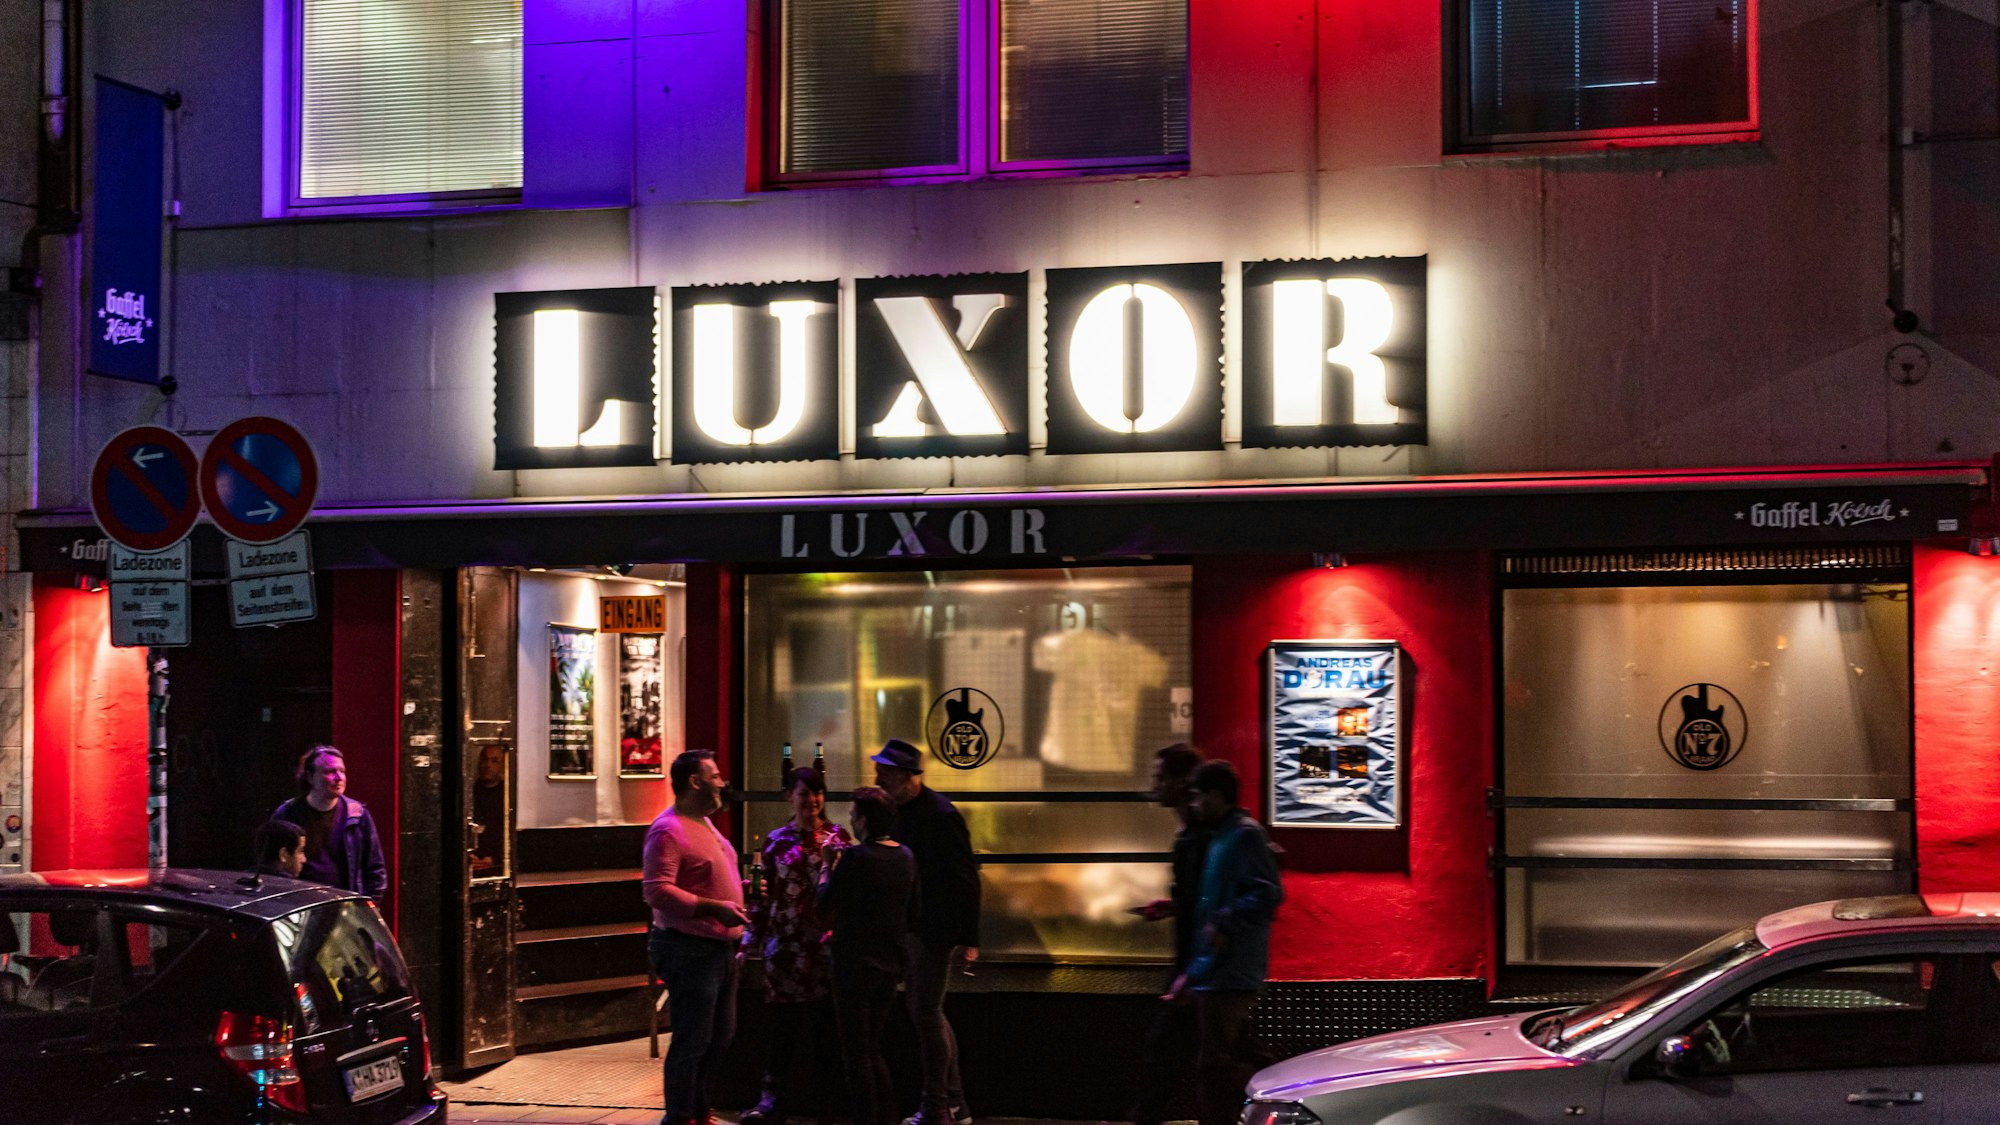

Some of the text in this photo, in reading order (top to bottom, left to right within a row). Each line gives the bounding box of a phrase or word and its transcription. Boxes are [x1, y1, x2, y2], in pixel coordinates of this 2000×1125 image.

[106, 288, 145, 320] Gaffel
[533, 277, 1399, 448] LUXOR
[1751, 502, 1820, 528] Gaffel
[780, 509, 1047, 558] LUXOR
[71, 538, 109, 562] Gaff
[113, 553, 182, 571] Ladezone
[238, 550, 298, 568] Ladezone
[132, 585, 170, 596] auf dem
[249, 583, 294, 599] auf dem
[604, 599, 662, 629] EINGANG
[1296, 657, 1373, 668] ANDREAS
